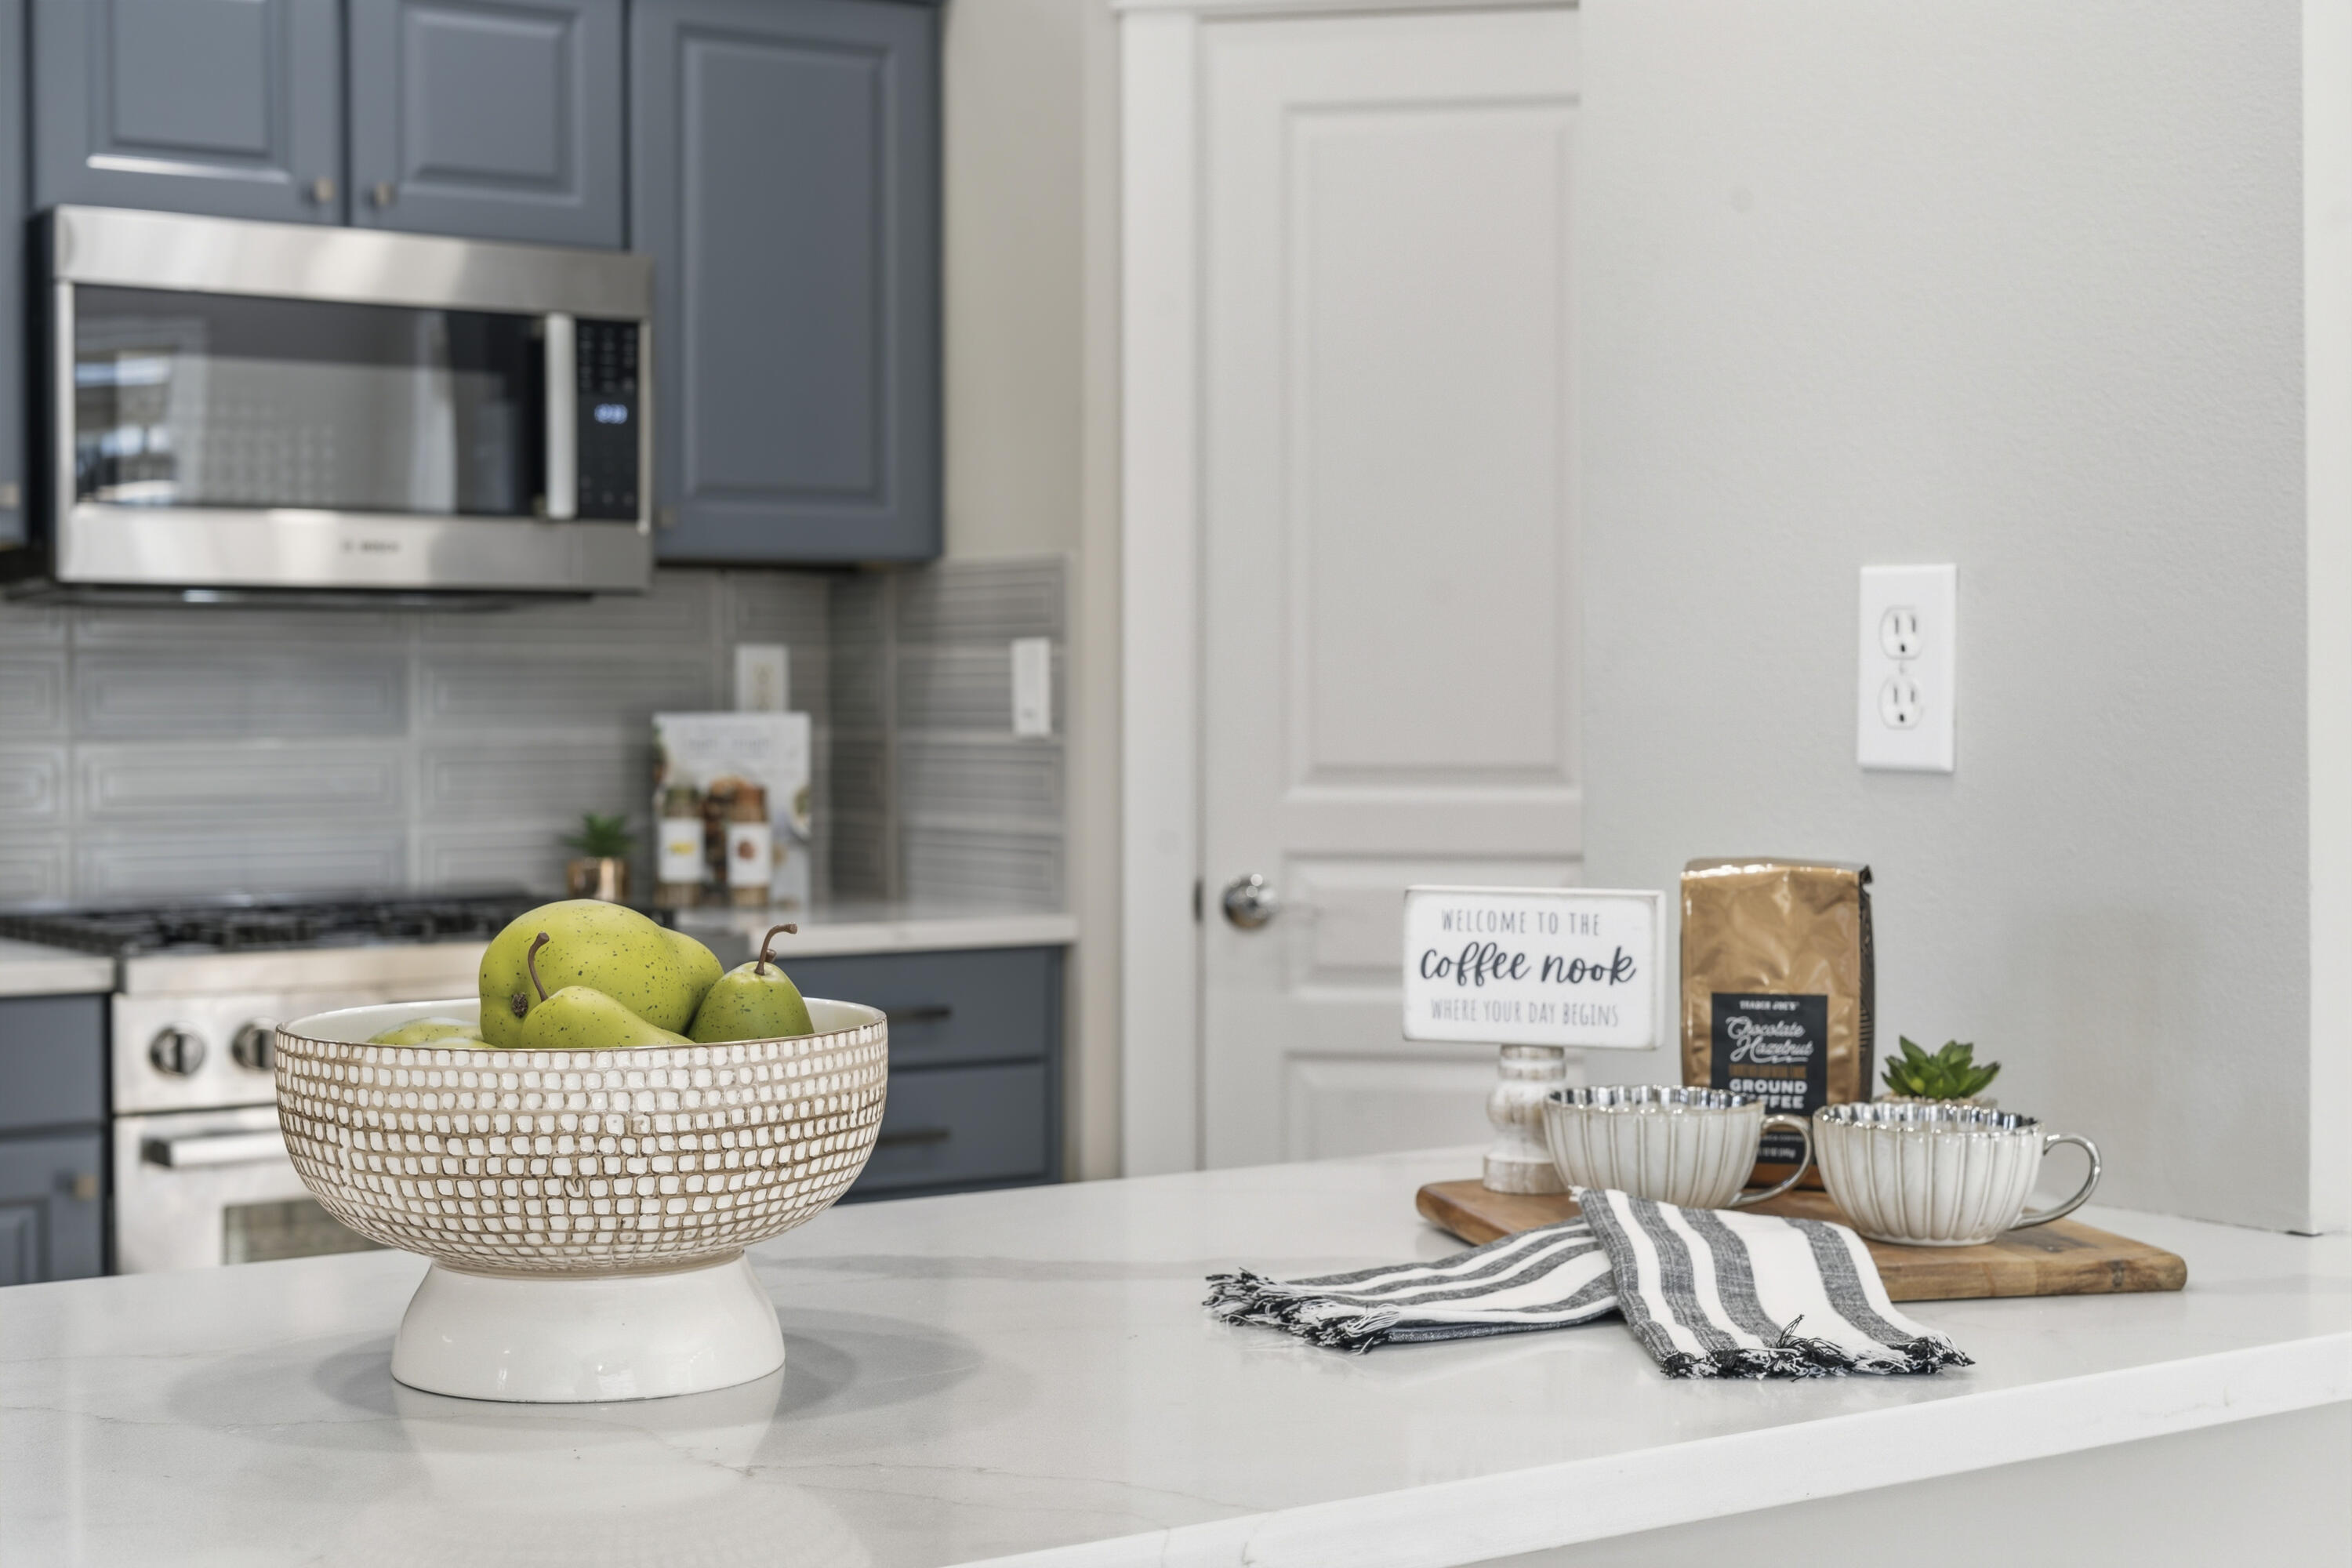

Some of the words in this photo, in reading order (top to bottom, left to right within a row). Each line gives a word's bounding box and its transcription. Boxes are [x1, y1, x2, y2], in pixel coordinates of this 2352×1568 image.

[1441, 909, 1526, 934] WELCOME
[1537, 911, 1559, 935] TO
[1570, 913, 1600, 937] THE
[1420, 942, 1530, 987] coffee
[1541, 946, 1636, 986] nook
[1431, 998, 1476, 1021] WHERE
[1483, 1000, 1522, 1024] YOUR
[1529, 1002, 1556, 1025] DAY
[1563, 1003, 1619, 1027] BEGINS
[1740, 1000, 1771, 1010] TRADER
[1725, 1015, 1806, 1040] Chocolate
[1730, 1035, 1814, 1063] Hazelnut
[1730, 1078, 1808, 1094] GROUND
